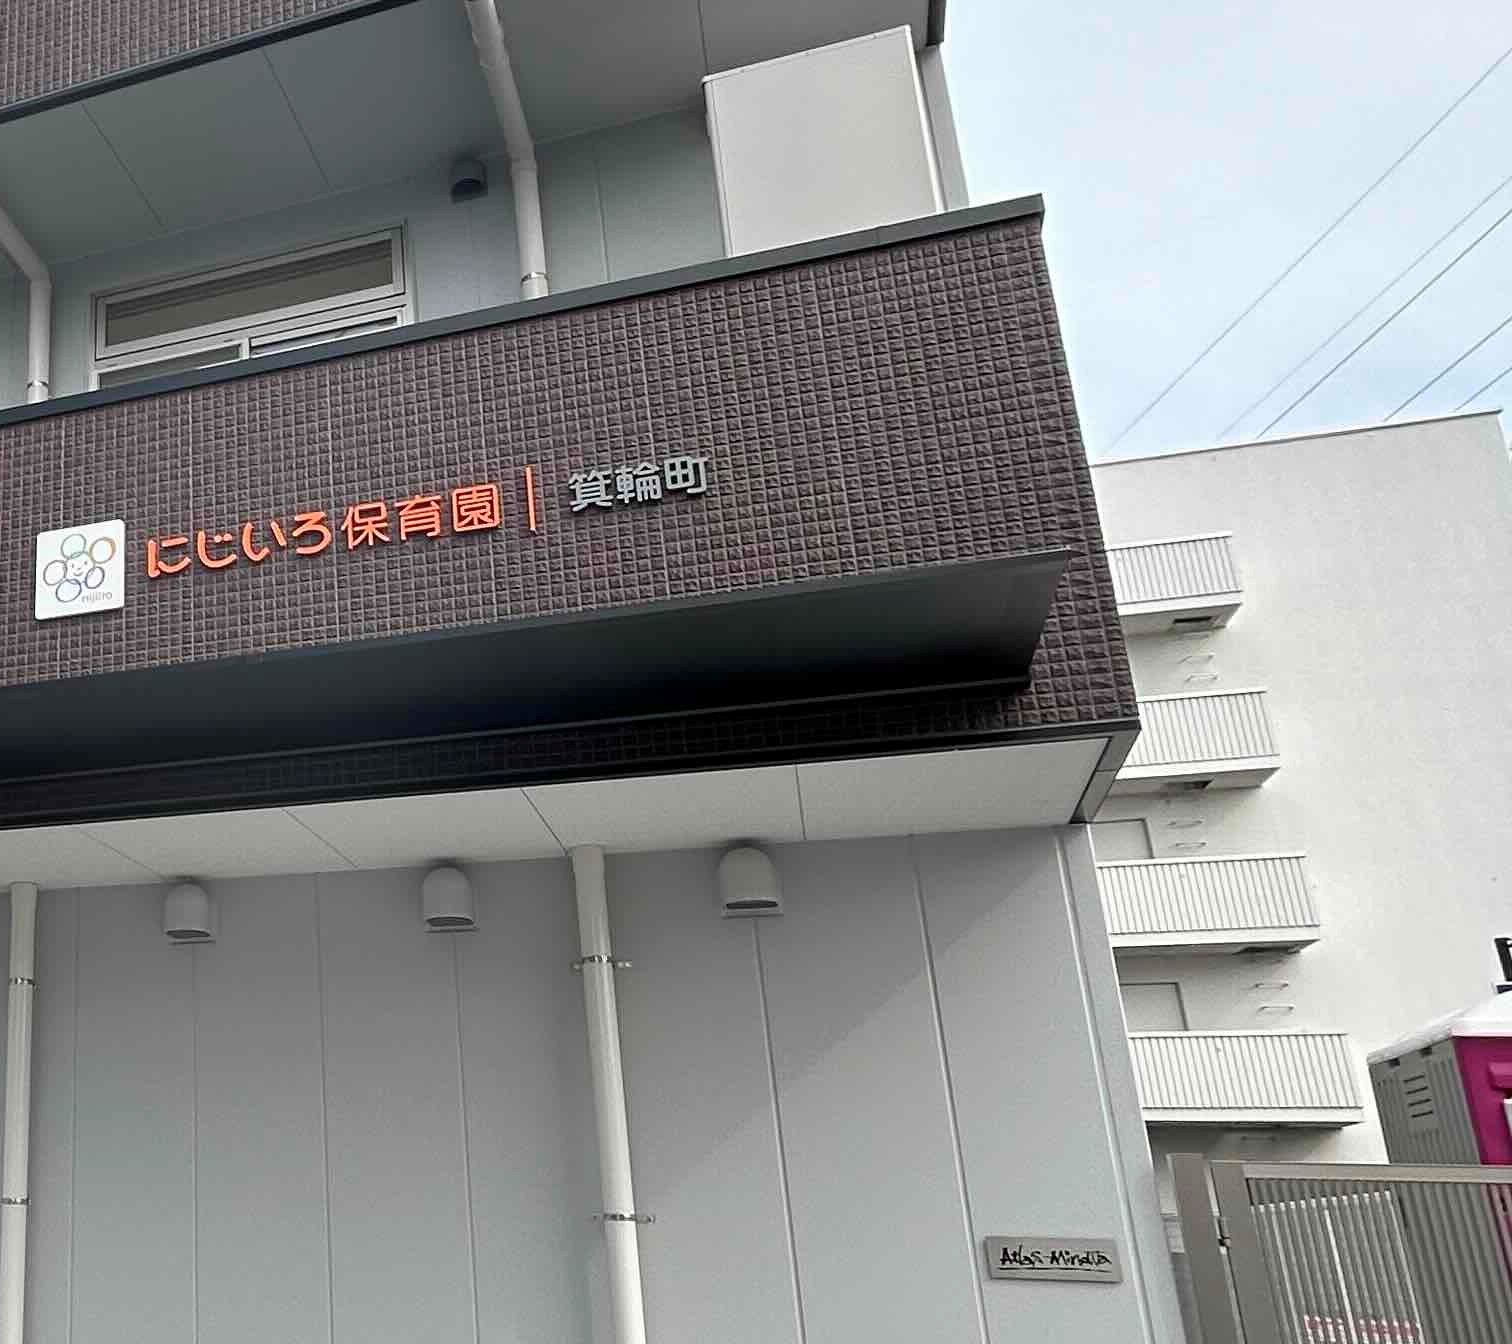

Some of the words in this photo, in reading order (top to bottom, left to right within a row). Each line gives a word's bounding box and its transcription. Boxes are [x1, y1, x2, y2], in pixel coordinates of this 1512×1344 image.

[568, 455, 710, 513] 箕輪町
[146, 483, 502, 579] にじいろ保育園
